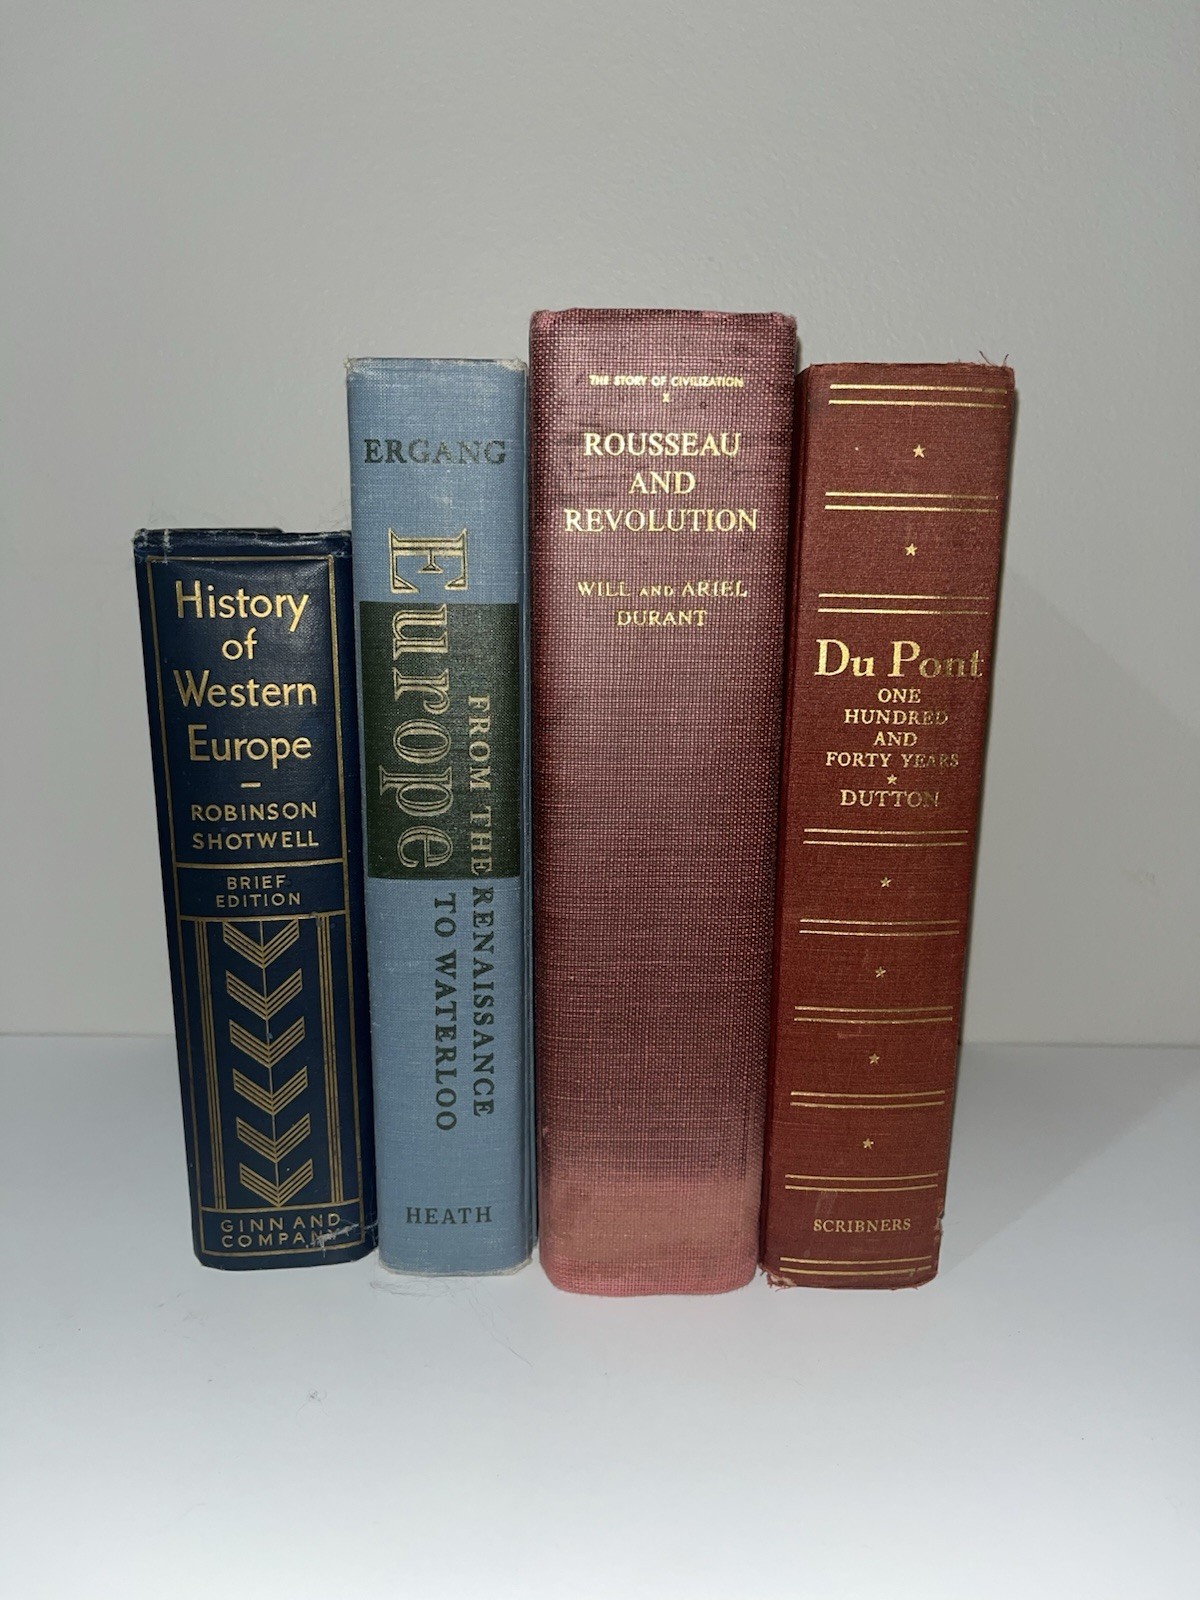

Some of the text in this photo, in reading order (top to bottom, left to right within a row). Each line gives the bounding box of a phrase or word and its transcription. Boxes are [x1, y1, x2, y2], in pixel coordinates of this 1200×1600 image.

[589, 375, 745, 388] THE STORY OF CIVILIZATION
[364, 438, 506, 465] ERGANG
[584, 433, 741, 456] ROUSSEAU
[629, 471, 696, 494] AND
[564, 508, 758, 532] REVOLUTION
[578, 580, 748, 598] WILL AND ARIEL
[174, 579, 309, 632] History
[617, 610, 707, 627] DURANT
[222, 627, 257, 661] of
[814, 639, 984, 678] Du Pont
[173, 669, 317, 708] Western
[380, 527, 469, 869] Europe
[877, 688, 921, 704] ONE
[844, 709, 949, 726] HUNDRED
[187, 724, 312, 769] Europe
[873, 731, 918, 747] AND
[826, 752, 959, 768] FORTY YEARS
[840, 789, 939, 808] DUTTON
[191, 801, 317, 822] ROBINSON
[192, 831, 319, 850] SHOTWELL
[227, 874, 286, 891] BRIEF
[216, 892, 301, 909] EDITION
[468, 695, 495, 1118] FROM THE RENAISSANCE
[434, 892, 458, 1131] TO WATERLOO
[221, 1213, 341, 1233] GINN AND
[406, 1206, 492, 1225] HEATH
[813, 1218, 911, 1233] SCRIBNERS
